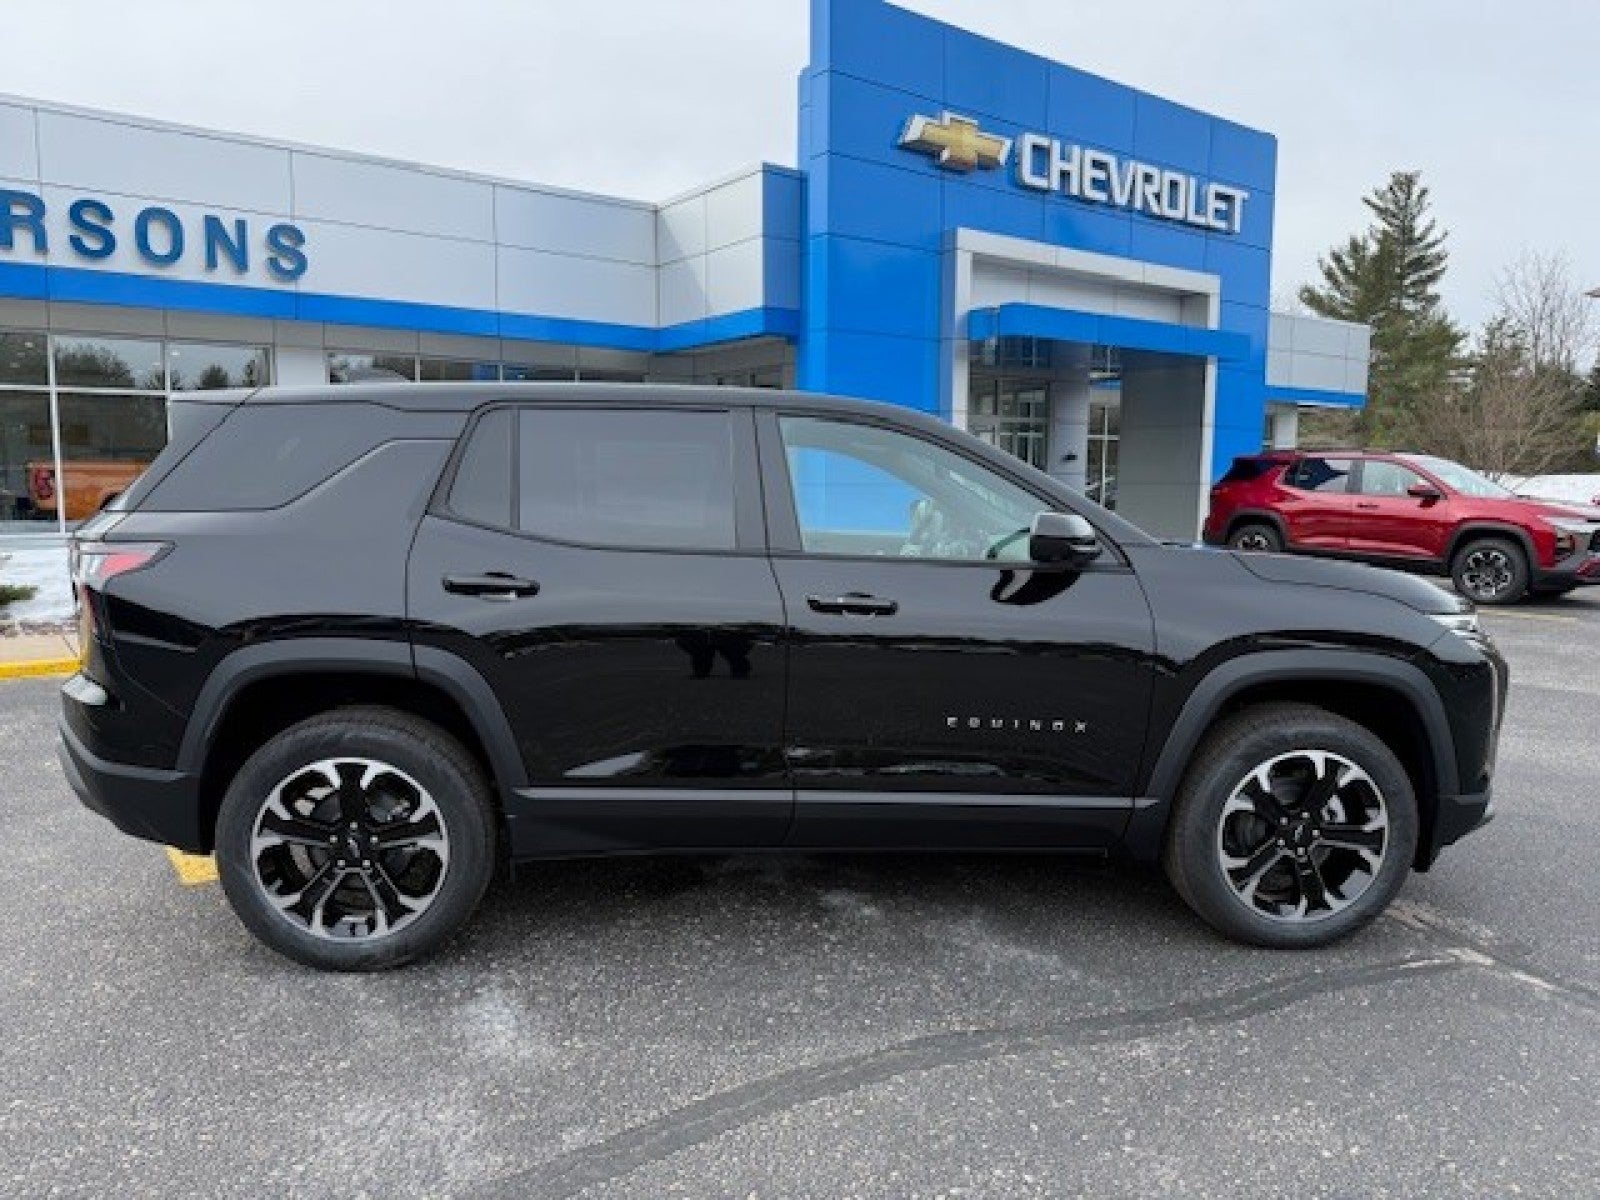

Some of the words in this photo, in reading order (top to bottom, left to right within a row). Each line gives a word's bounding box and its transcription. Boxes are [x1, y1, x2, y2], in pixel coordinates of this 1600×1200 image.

[1016, 132, 1248, 233] CHEVROLET
[0, 187, 309, 281] RSONS
[946, 716, 1087, 733] EQUINOX
